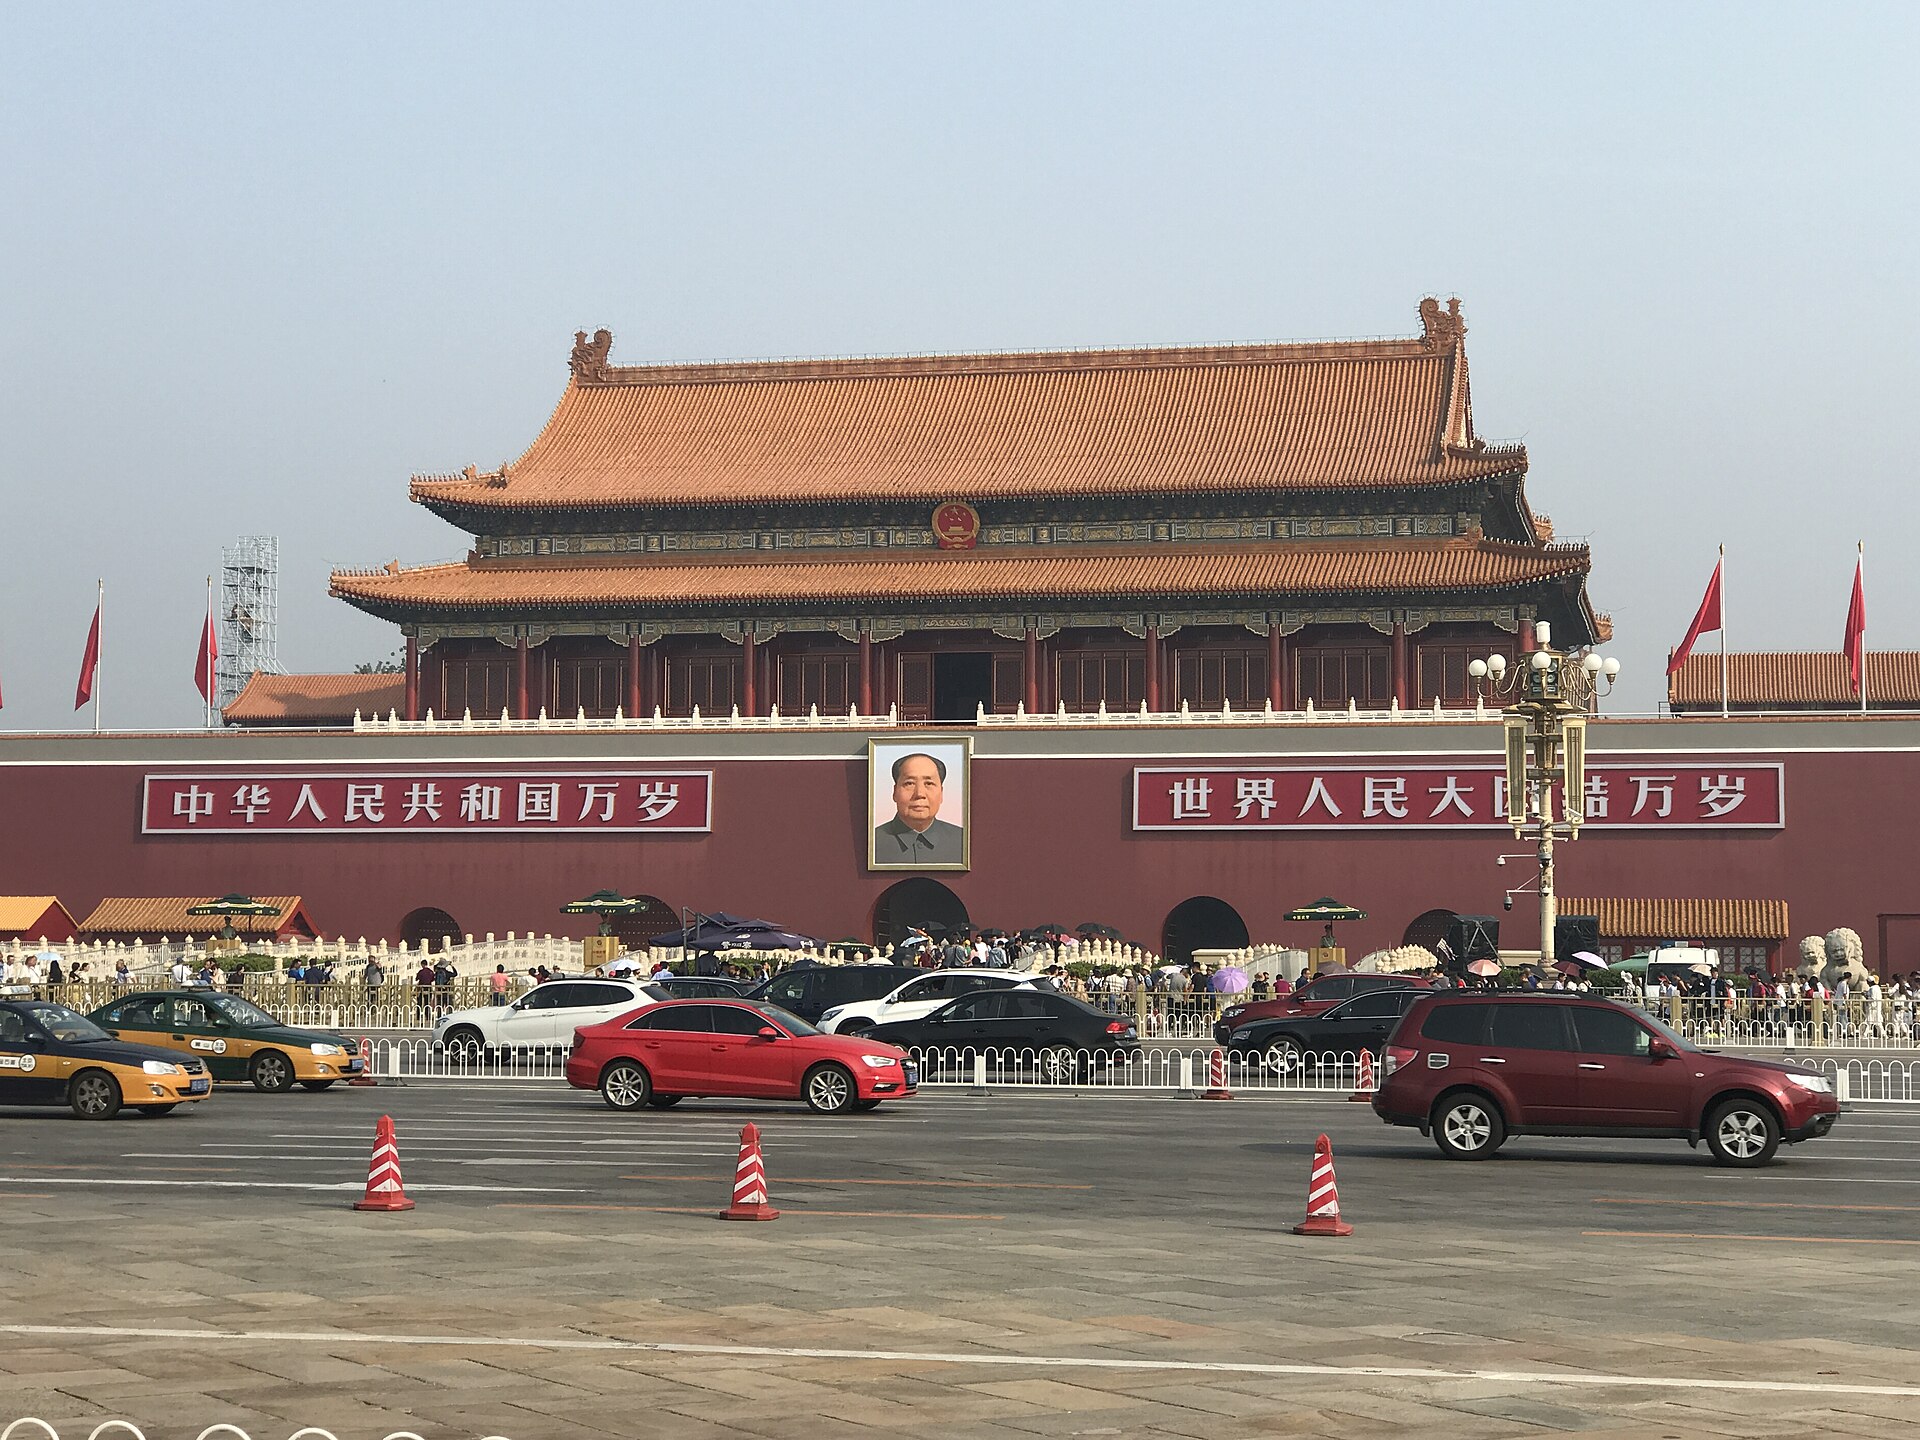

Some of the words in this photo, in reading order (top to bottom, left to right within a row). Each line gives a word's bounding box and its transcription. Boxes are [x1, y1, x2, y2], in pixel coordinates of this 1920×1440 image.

[174, 782, 680, 823] 中华人民共和国万岁
